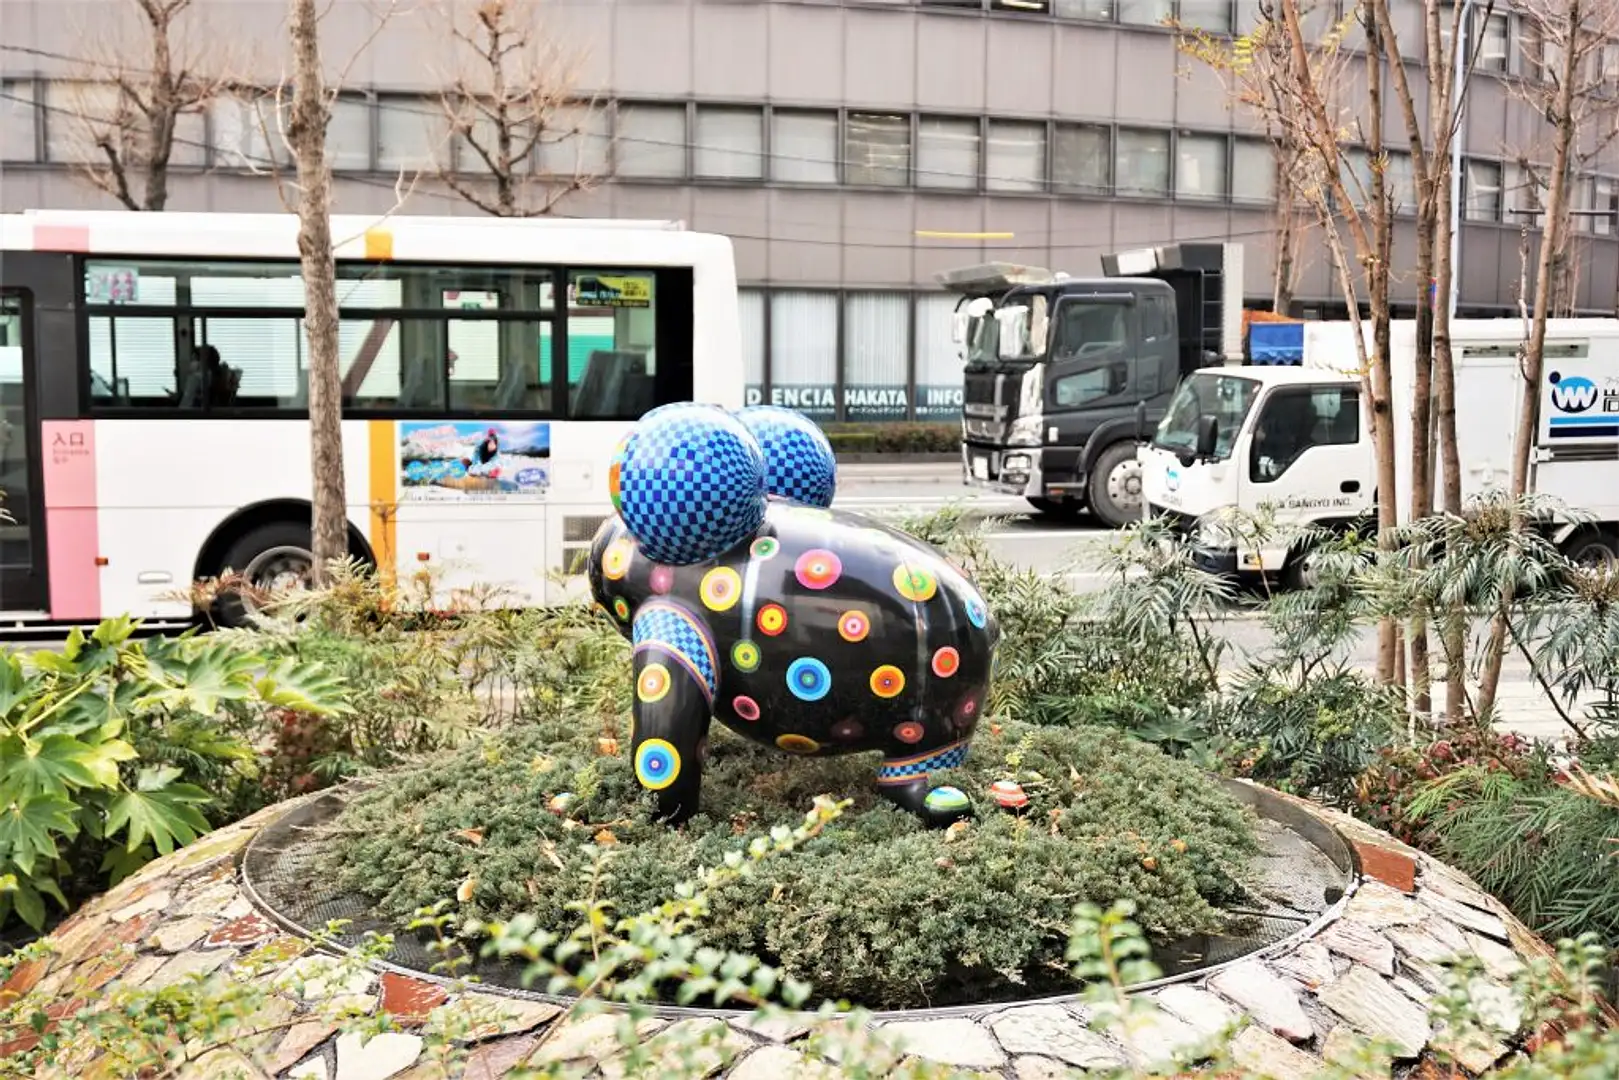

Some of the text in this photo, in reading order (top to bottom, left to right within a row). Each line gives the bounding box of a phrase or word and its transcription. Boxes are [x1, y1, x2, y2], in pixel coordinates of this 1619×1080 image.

[844, 388, 908, 406] HAKATA
[927, 389, 963, 406] INFO
[52, 432, 84, 446] 入口
